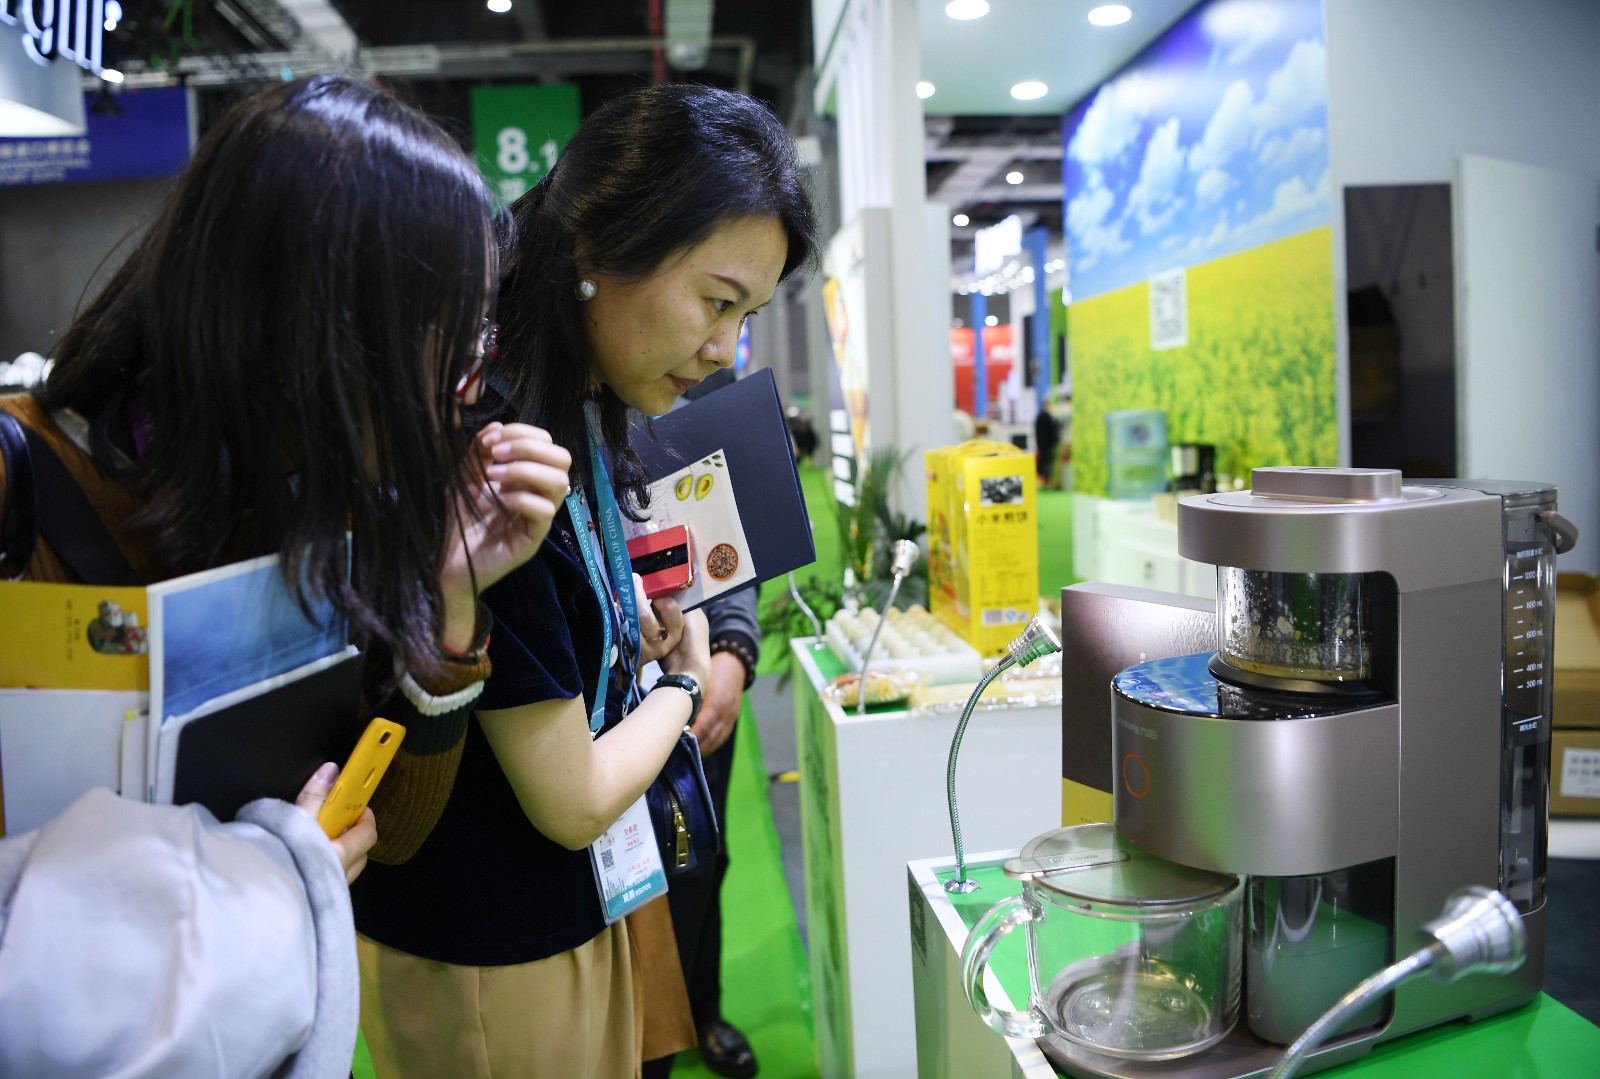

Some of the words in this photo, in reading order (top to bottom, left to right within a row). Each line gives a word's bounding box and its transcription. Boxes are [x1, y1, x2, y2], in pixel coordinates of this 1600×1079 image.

[605, 507, 617, 539] CHINA
[571, 499, 592, 558] STRATEGIC
[611, 542, 620, 553] OF
[614, 555, 627, 580] BANK
[1524, 570, 1535, 579] 1000
[1526, 600, 1536, 609] 800
[1526, 630, 1536, 639] 600
[1526, 663, 1536, 672] 400
[1526, 680, 1536, 688] 300
